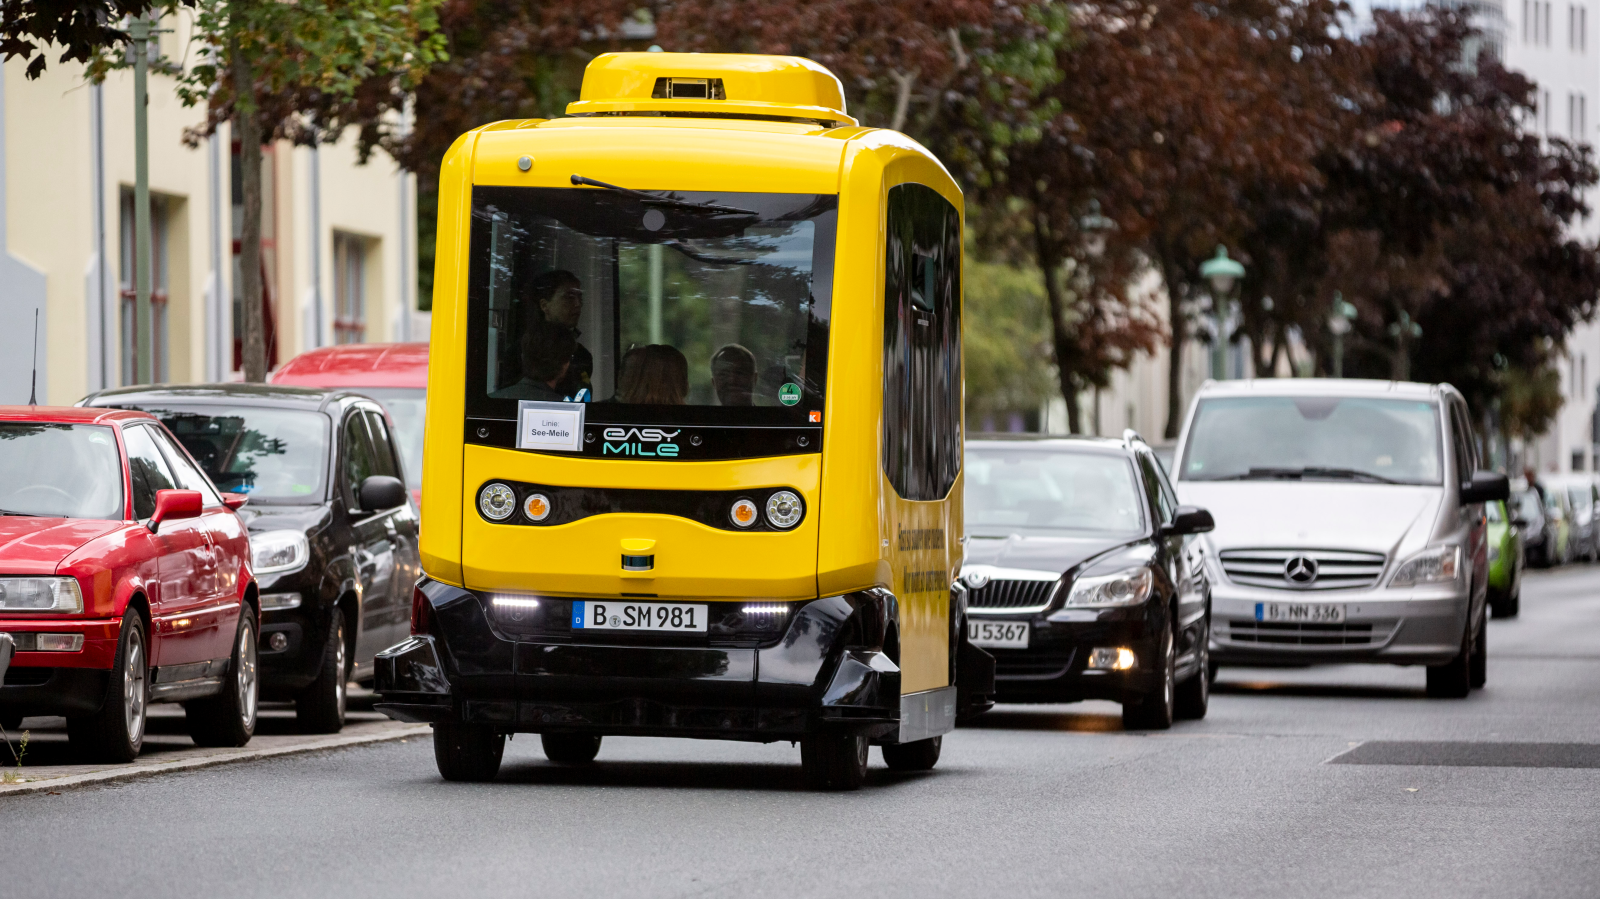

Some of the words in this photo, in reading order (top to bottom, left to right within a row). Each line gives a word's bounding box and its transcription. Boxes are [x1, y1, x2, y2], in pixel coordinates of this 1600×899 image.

[786, 384, 794, 394] 4
[541, 420, 560, 428] Linie:
[531, 428, 570, 438] See-Meile
[594, 604, 606, 626] B
[622, 606, 652, 628] SM
[656, 606, 697, 628] 981
[1289, 602, 1309, 620] NN
[1312, 603, 1339, 620] 336
[982, 624, 1026, 641] 5367
